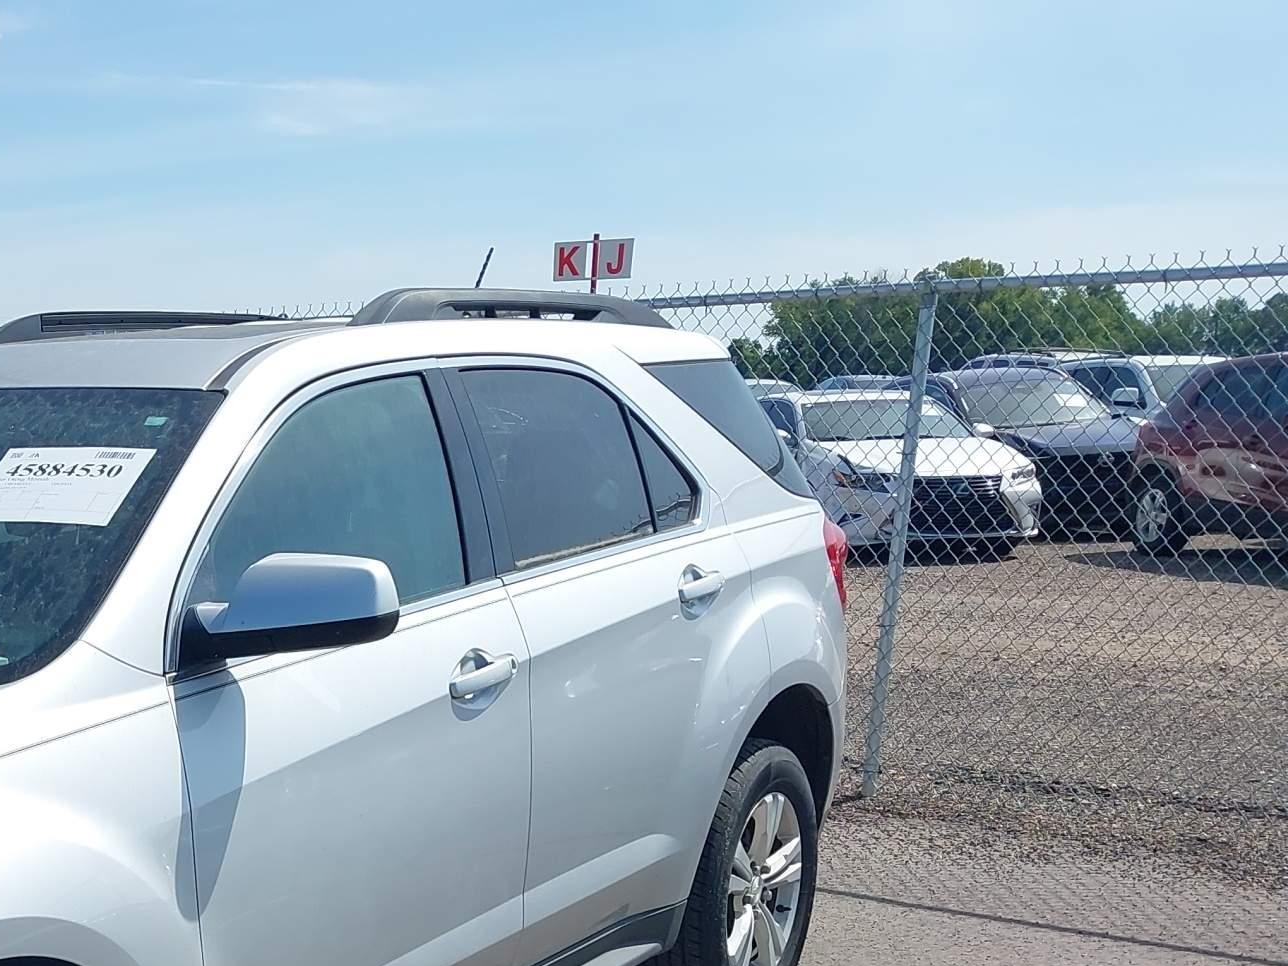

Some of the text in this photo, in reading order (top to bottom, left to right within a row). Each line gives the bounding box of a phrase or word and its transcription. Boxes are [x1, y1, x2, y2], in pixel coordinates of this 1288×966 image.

[557, 245, 581, 277] K
[605, 242, 626, 275] J
[5, 462, 124, 479] 45884530
